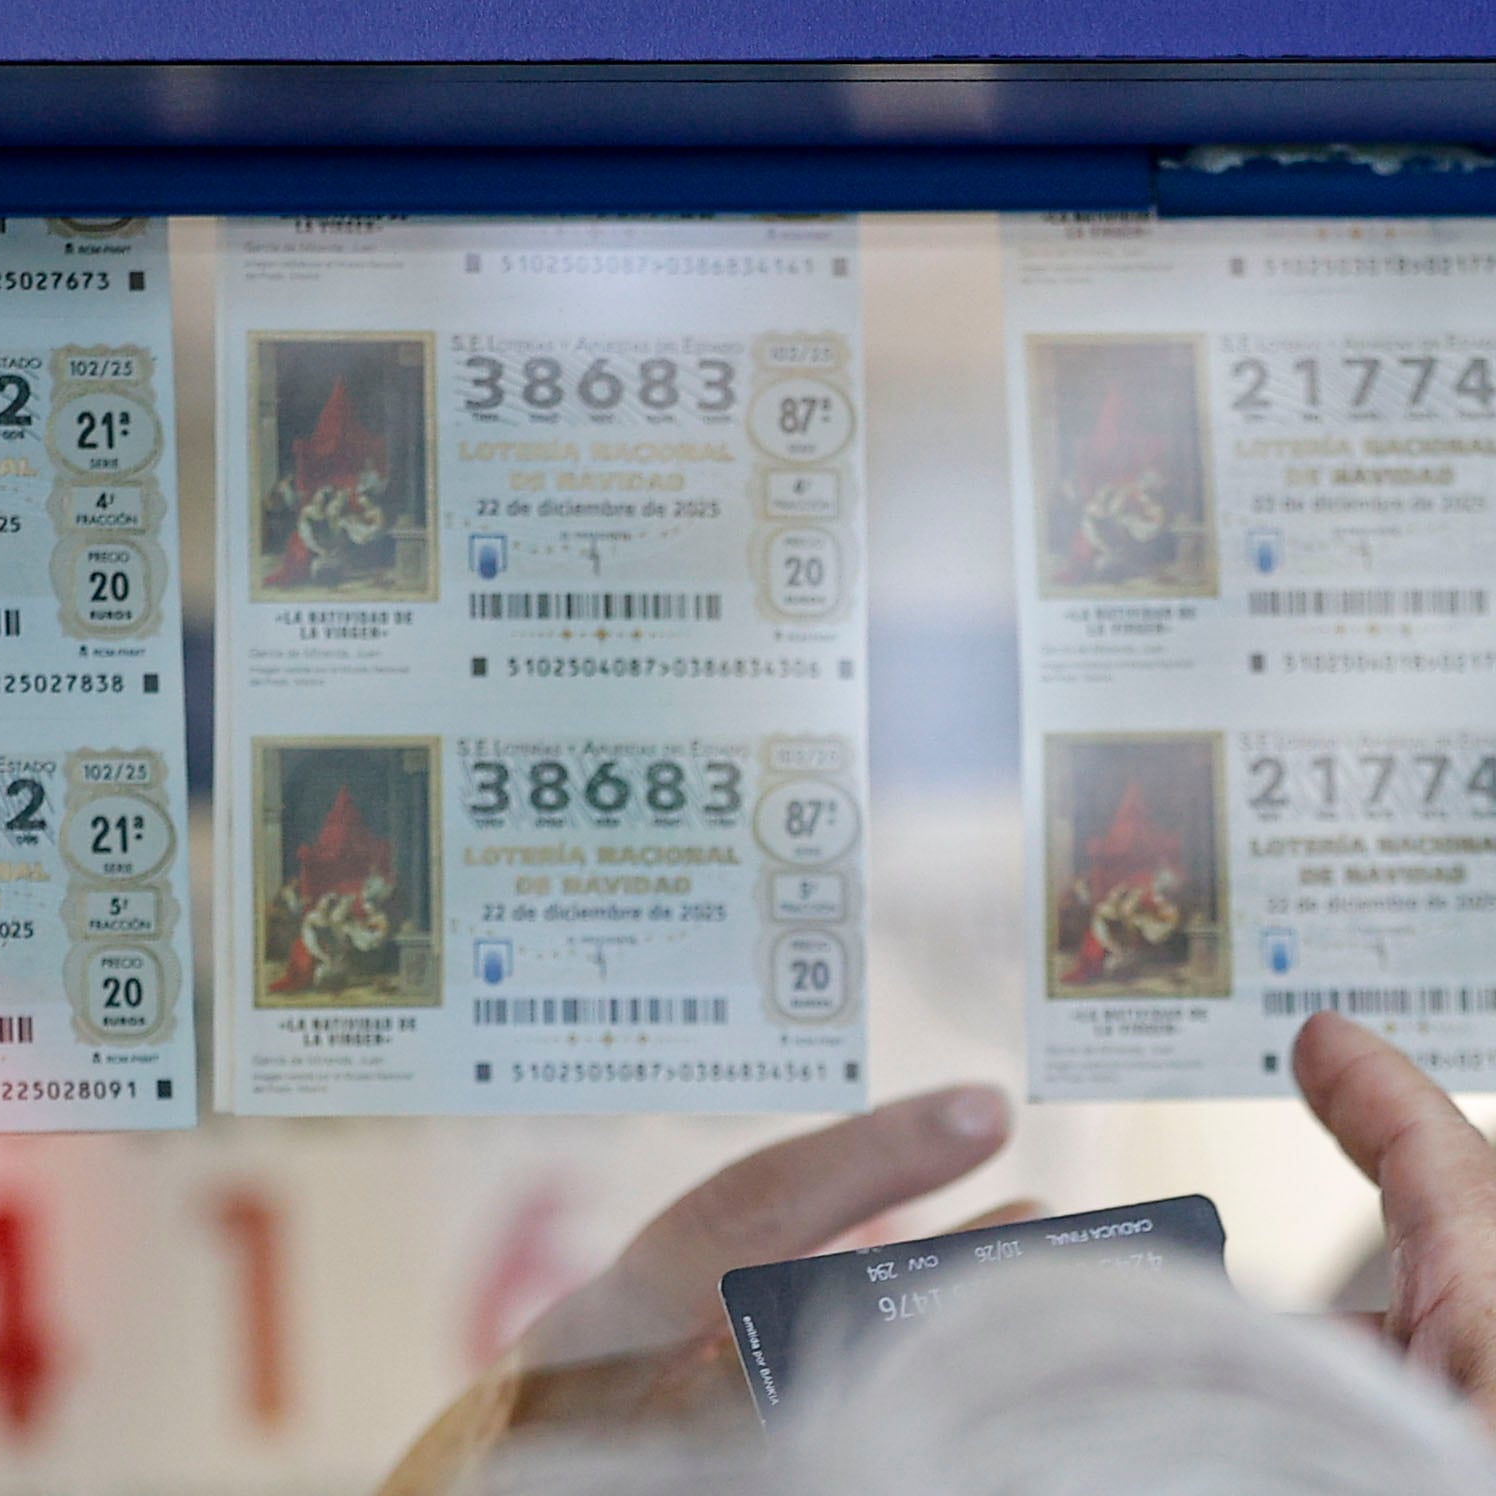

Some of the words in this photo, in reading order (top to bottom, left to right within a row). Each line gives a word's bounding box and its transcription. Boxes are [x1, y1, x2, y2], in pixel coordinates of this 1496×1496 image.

[71, 358, 133, 375] 102/25
[463, 357, 736, 410] 38683
[1232, 356, 1494, 408] 21774
[459, 436, 583, 460] LOTERÍA
[592, 440, 740, 461] NACIONAL
[511, 470, 548, 490] DE
[559, 470, 691, 490] NAVIDAD
[785, 553, 824, 586] 20
[89, 569, 130, 602] 20
[85, 760, 148, 778] 102/25
[470, 761, 742, 814] 38683
[465, 840, 588, 865] LOTERÍA
[598, 843, 745, 864] NACIONAL
[516, 875, 553, 895] DE
[564, 874, 696, 894] NAVIDAD
[792, 955, 830, 988] 20
[103, 973, 143, 1005] 20
[1046, 1229, 1089, 1246] FINAL
[1090, 1219, 1153, 1240] CADUCA
[908, 1255, 939, 1272] CVV
[743, 1316, 761, 1349] emitida
[752, 1350, 767, 1366] por
[759, 1367, 779, 1406] BANKIA
